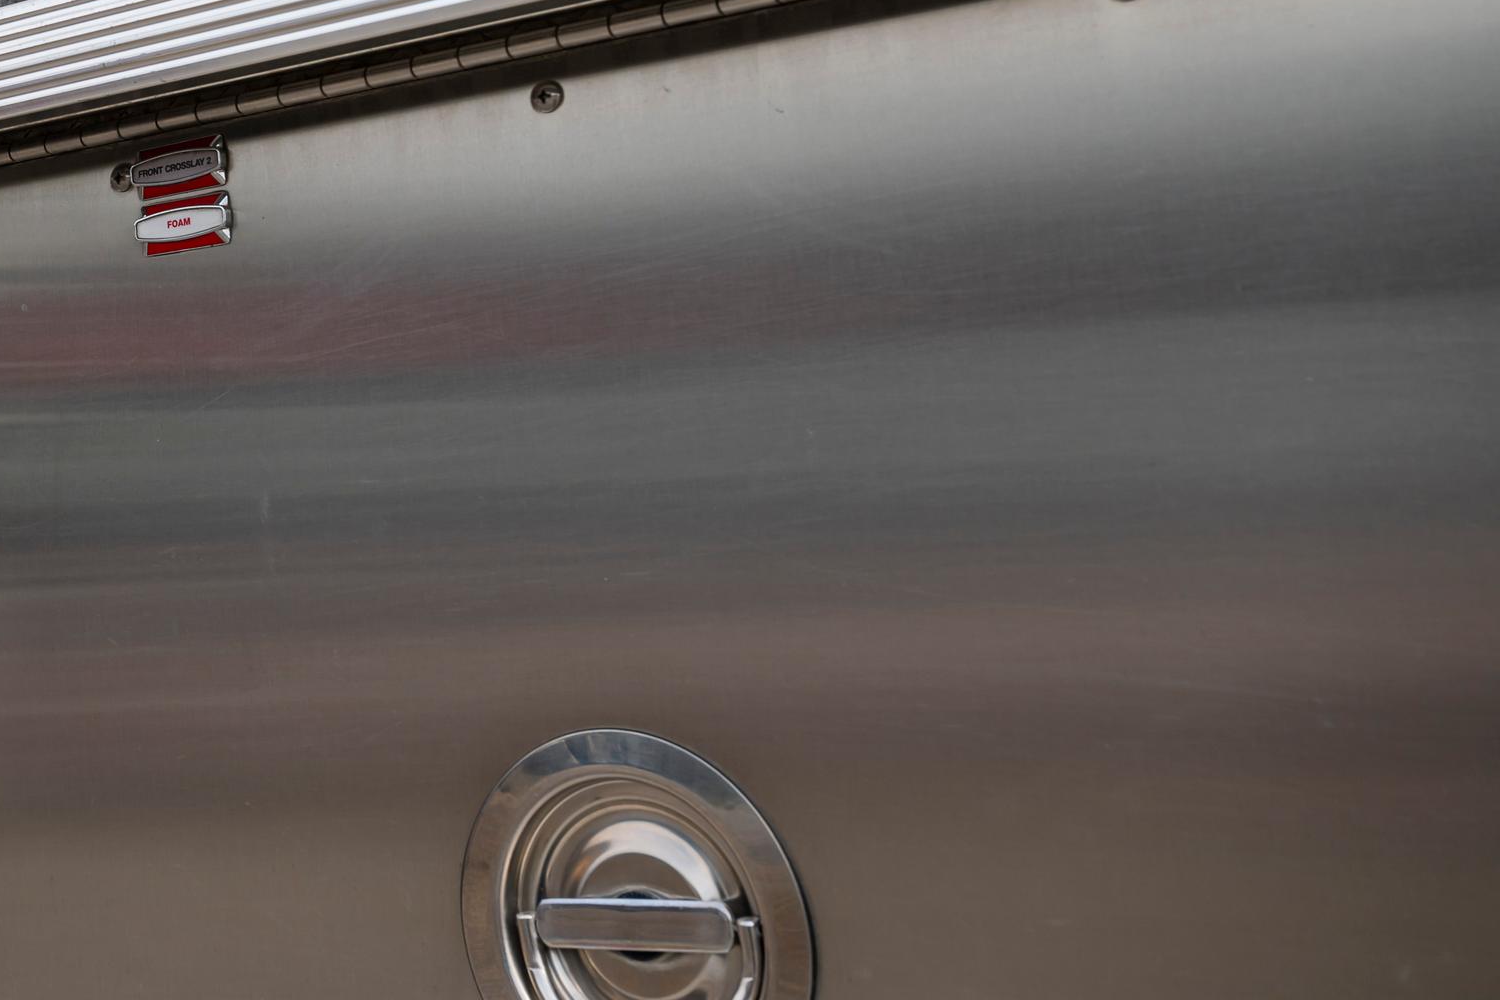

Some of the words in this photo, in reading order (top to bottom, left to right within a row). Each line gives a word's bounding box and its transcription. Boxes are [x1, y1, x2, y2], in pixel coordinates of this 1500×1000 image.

[138, 166, 163, 178] FRONT
[165, 158, 205, 173] CROSSLAY
[206, 157, 212, 165] 2
[167, 217, 191, 229] FOAM
